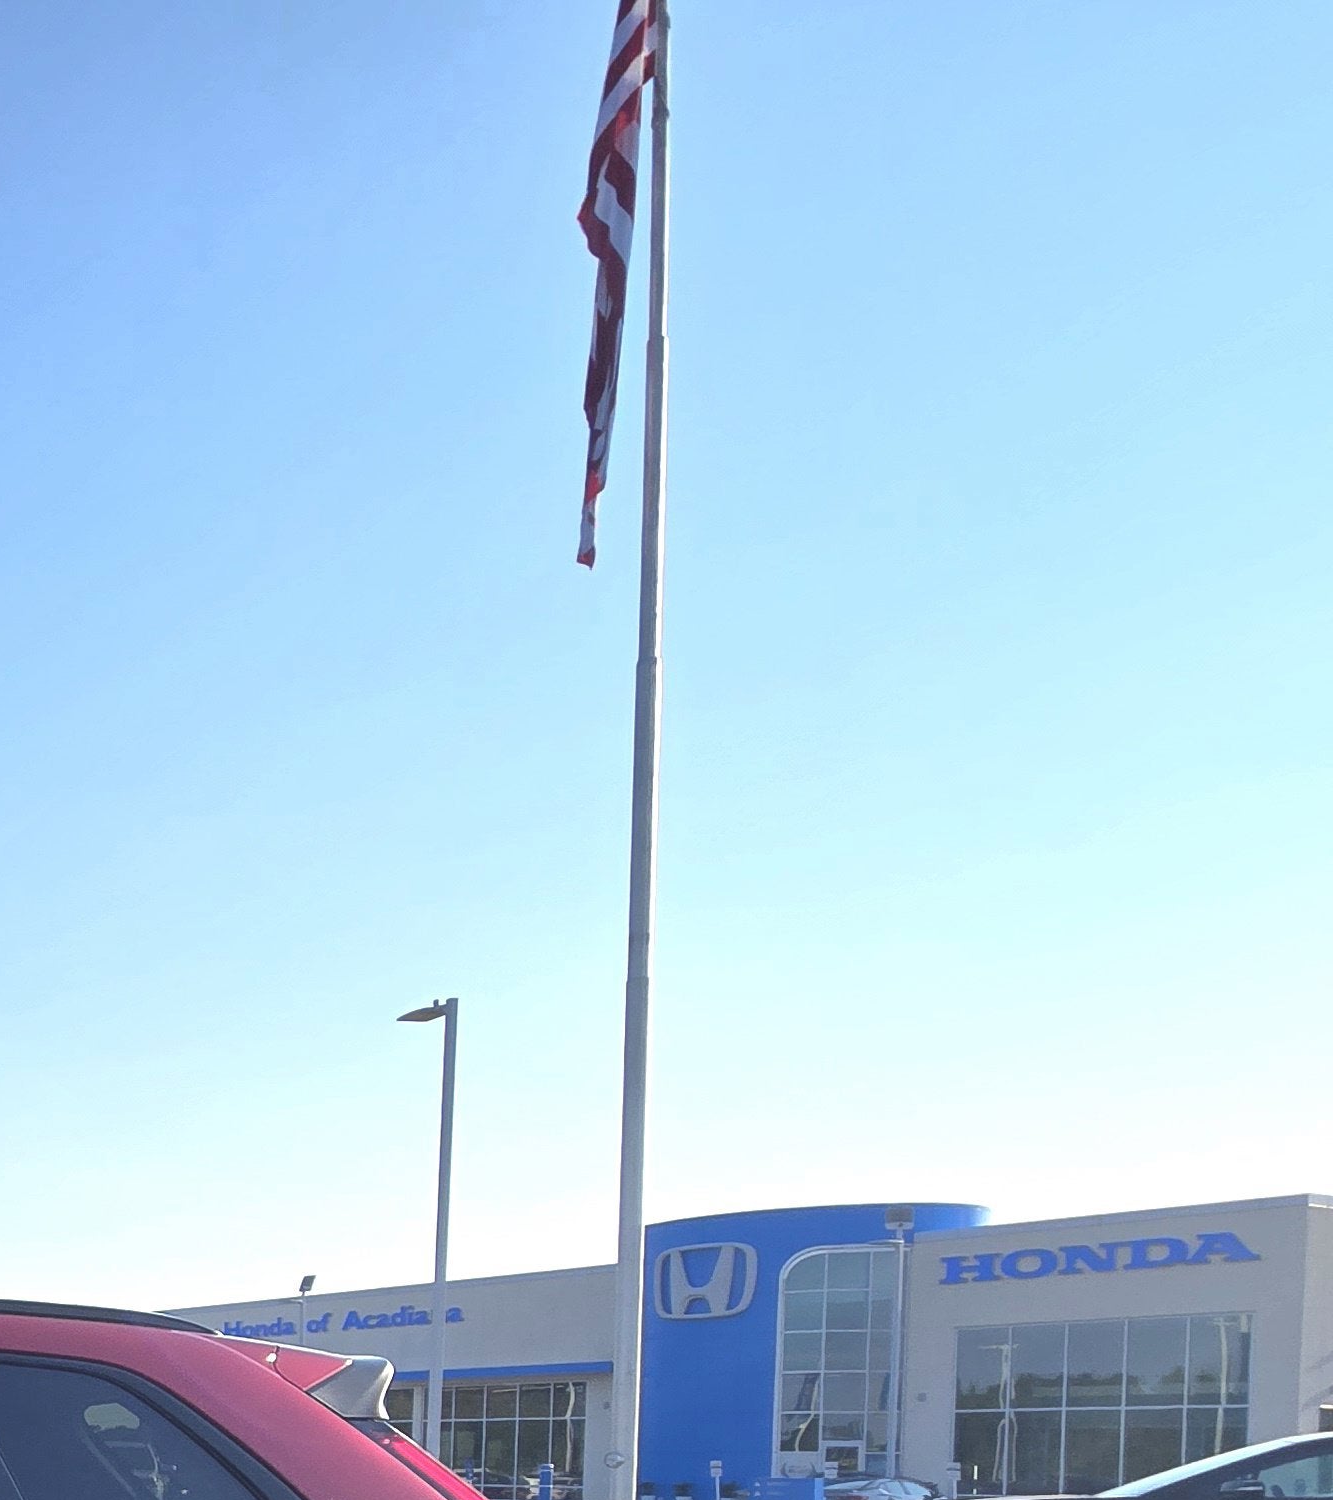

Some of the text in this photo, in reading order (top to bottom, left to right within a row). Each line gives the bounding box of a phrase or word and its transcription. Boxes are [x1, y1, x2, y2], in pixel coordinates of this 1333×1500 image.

[939, 1232, 1260, 1285] HONDA
[224, 1305, 465, 1337] Honda of Acadiaa
